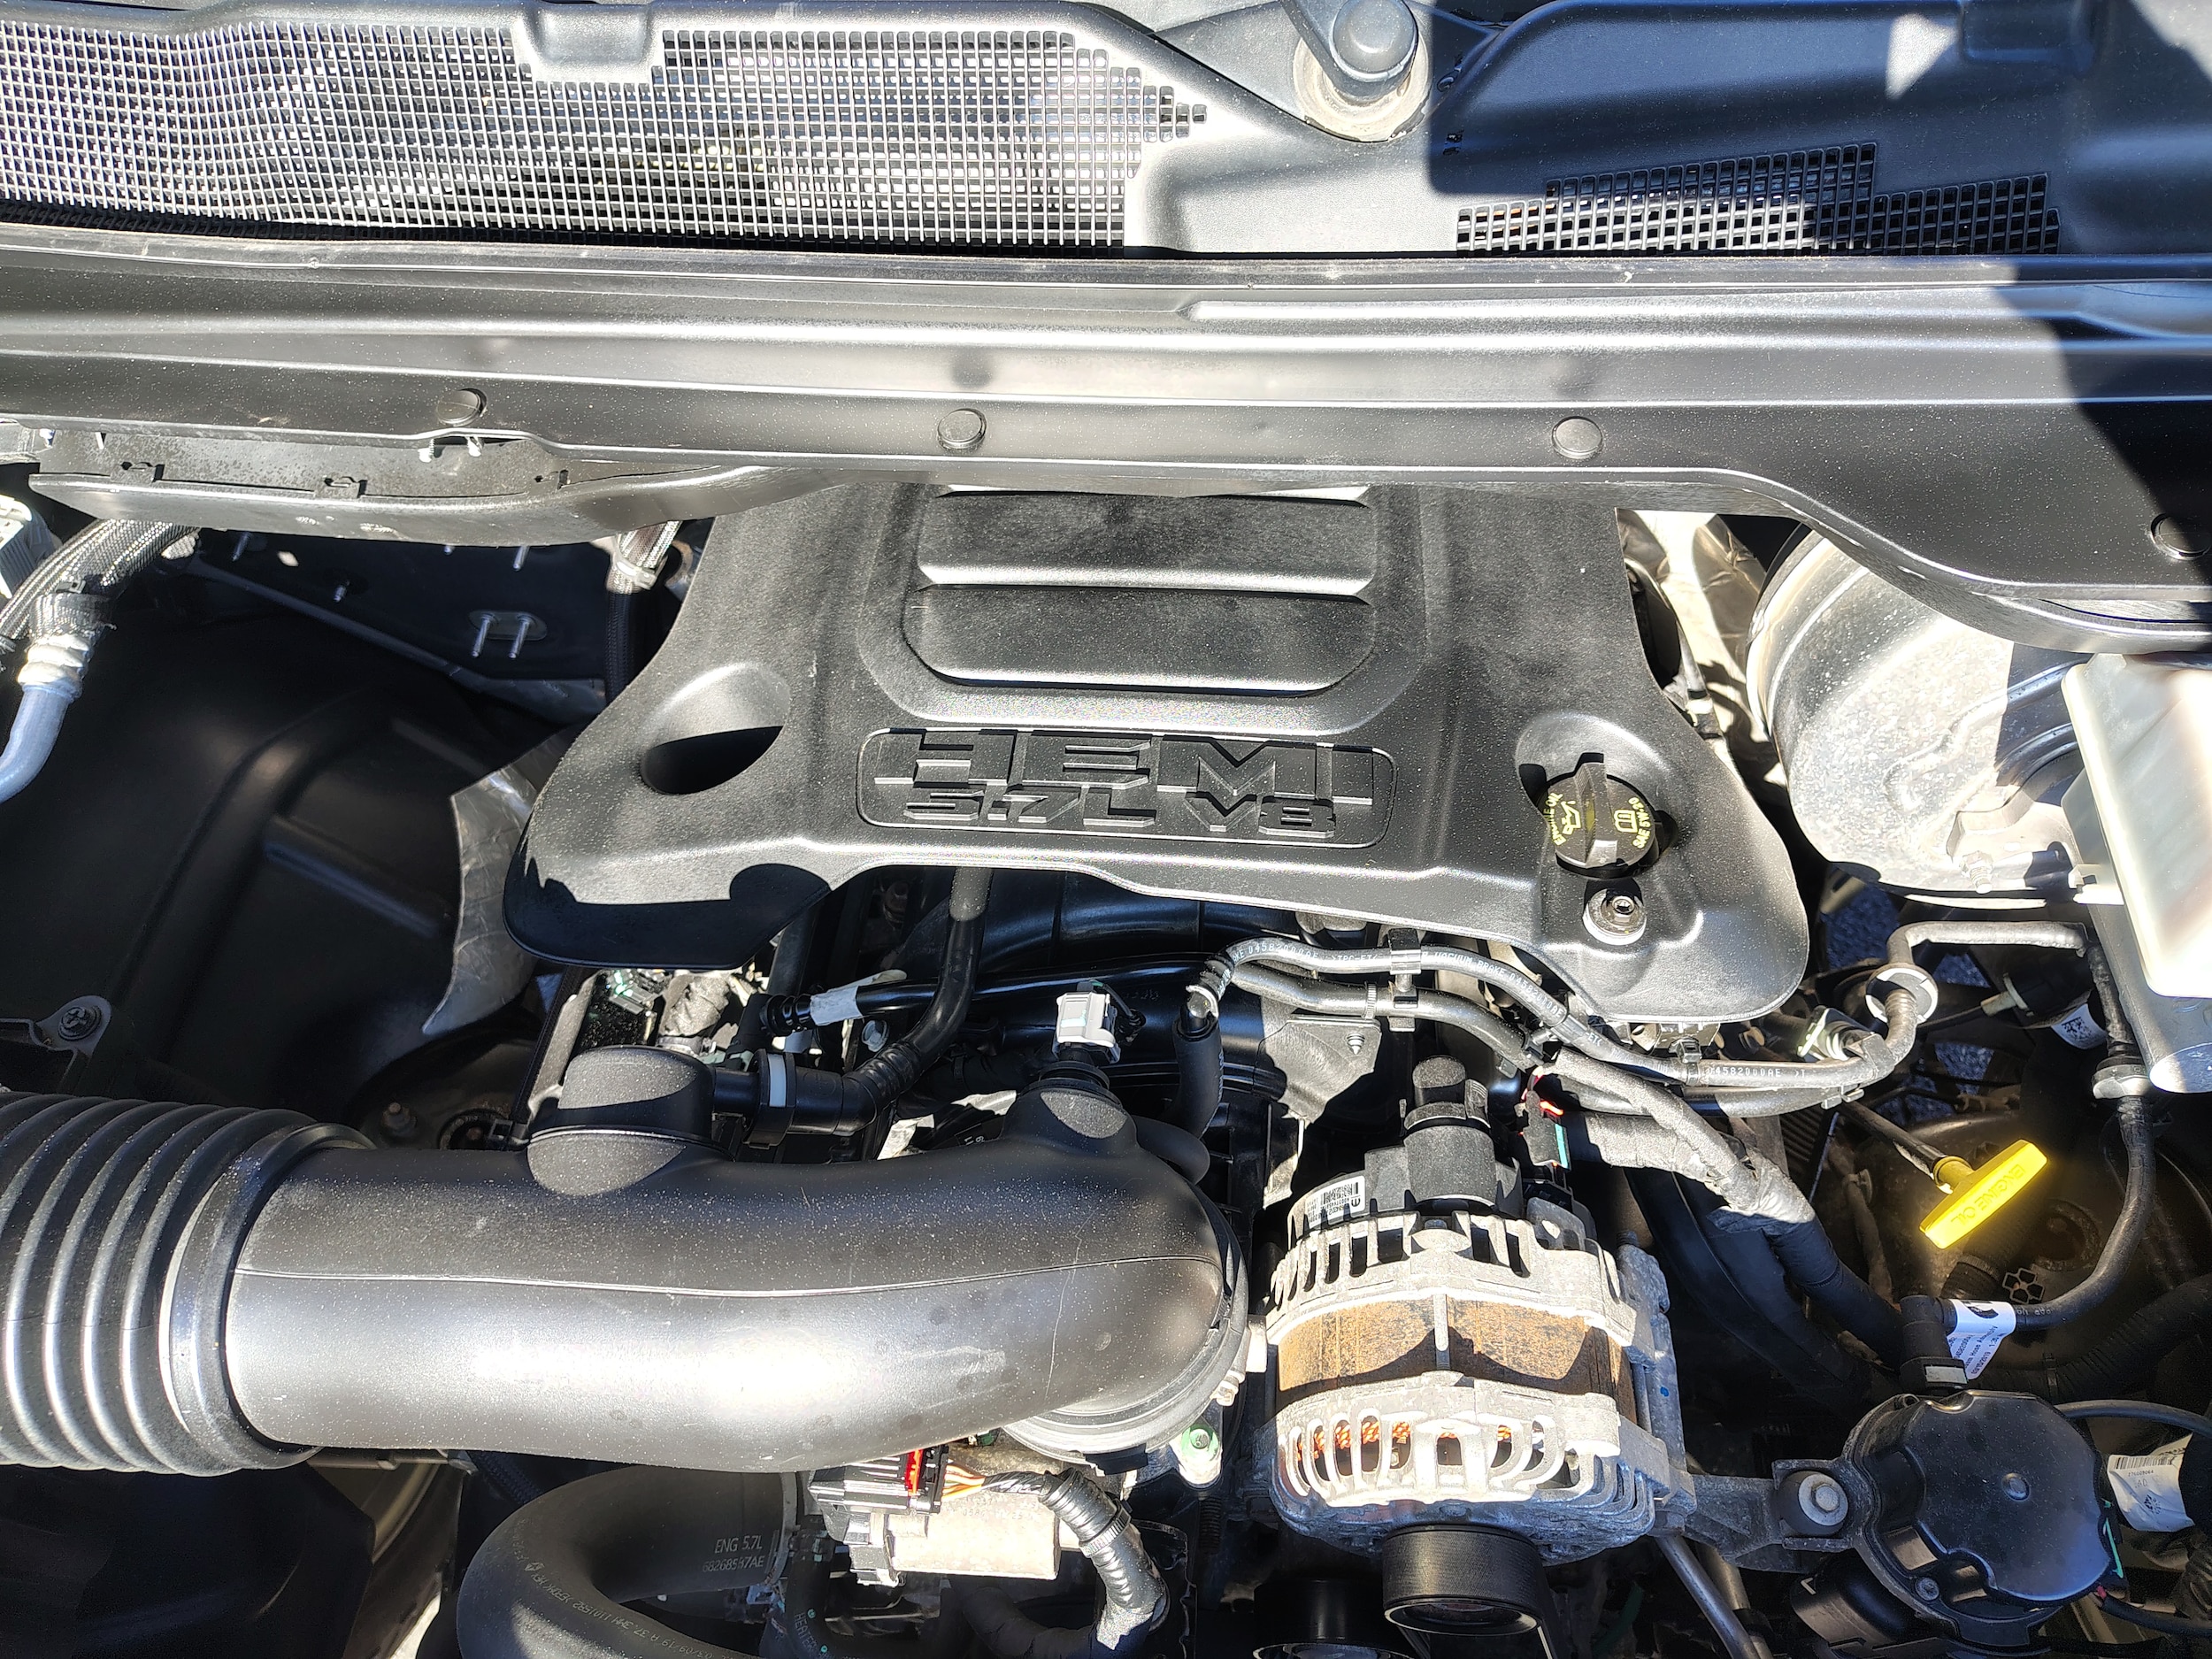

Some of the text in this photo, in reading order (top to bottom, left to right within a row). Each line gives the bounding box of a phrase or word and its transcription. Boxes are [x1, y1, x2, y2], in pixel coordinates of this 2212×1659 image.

[873, 728, 1373, 806] HEMI
[903, 784, 1335, 839] 5.7L V8
[1545, 792, 1563, 809] OIL
[1632, 828, 1650, 849] SAE
[1434, 951, 1473, 965] VACUUM
[1478, 959, 1506, 978] BRAKE
[1951, 1164, 2025, 1226] ENGINE OIL
[715, 1535, 763, 1554] ENG 5.7L
[794, 1612, 818, 1649] HEATER
